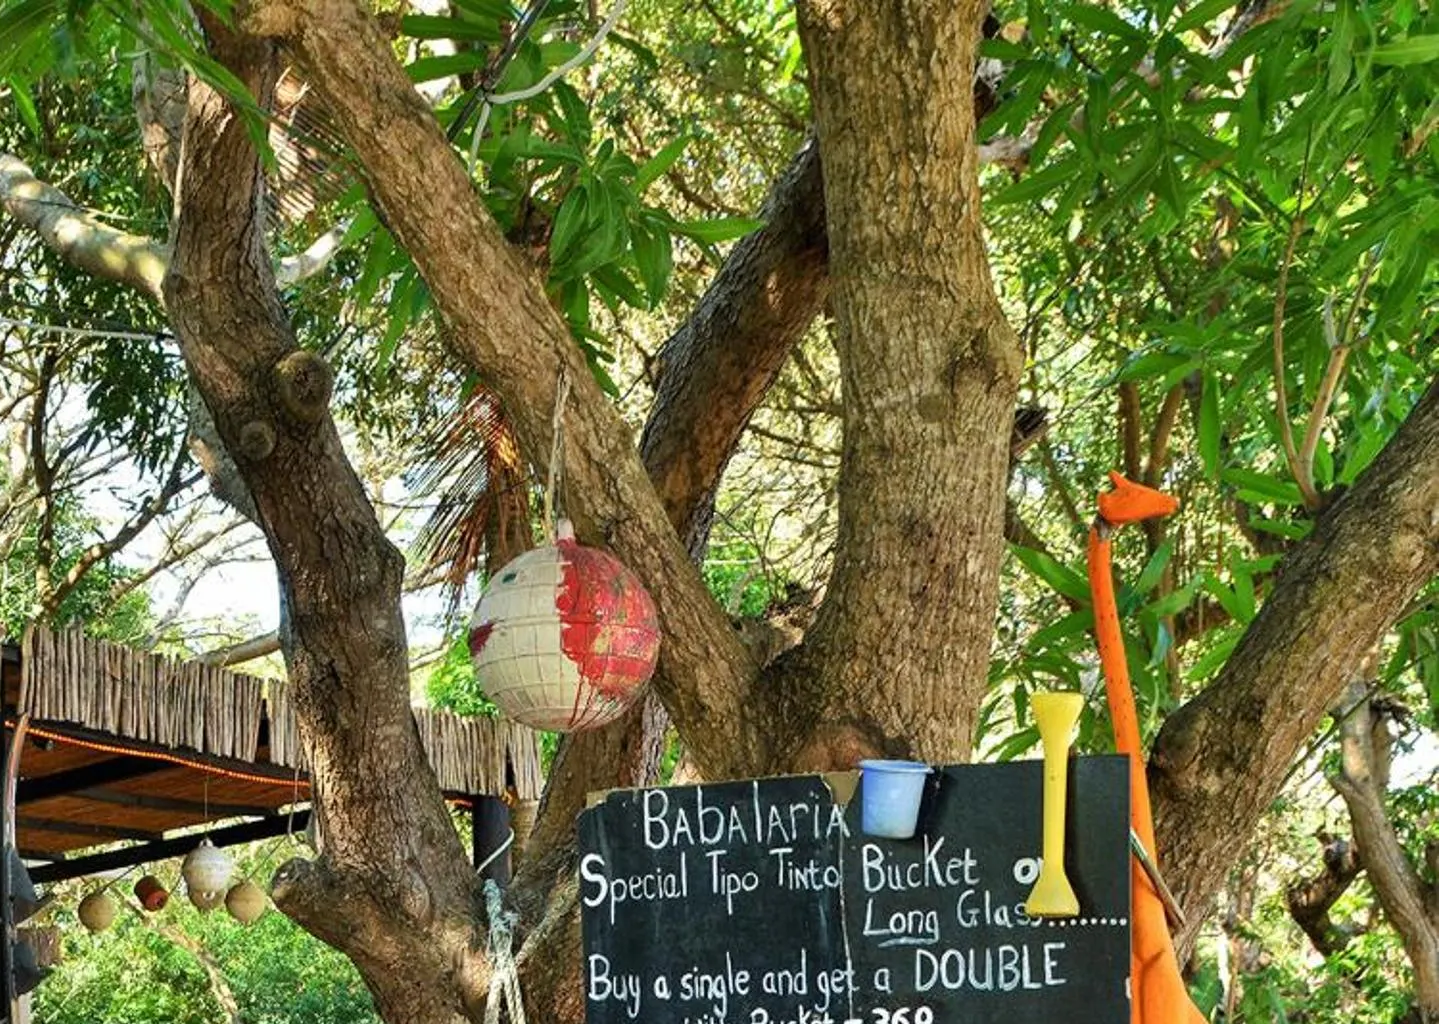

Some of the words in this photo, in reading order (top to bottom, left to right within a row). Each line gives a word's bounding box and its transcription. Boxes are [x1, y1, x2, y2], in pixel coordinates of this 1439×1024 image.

[580, 852, 687, 926] Special
[706, 849, 759, 915] Tipo
[1013, 857, 1044, 885] o
[863, 899, 938, 944] Long
[588, 954, 640, 1018] Buy
[654, 976, 672, 1000] a
[680, 951, 750, 1018] single
[763, 948, 808, 995] and
[815, 968, 859, 1013] get
[874, 968, 893, 995] a
[915, 942, 1067, 992] DOUBLE
